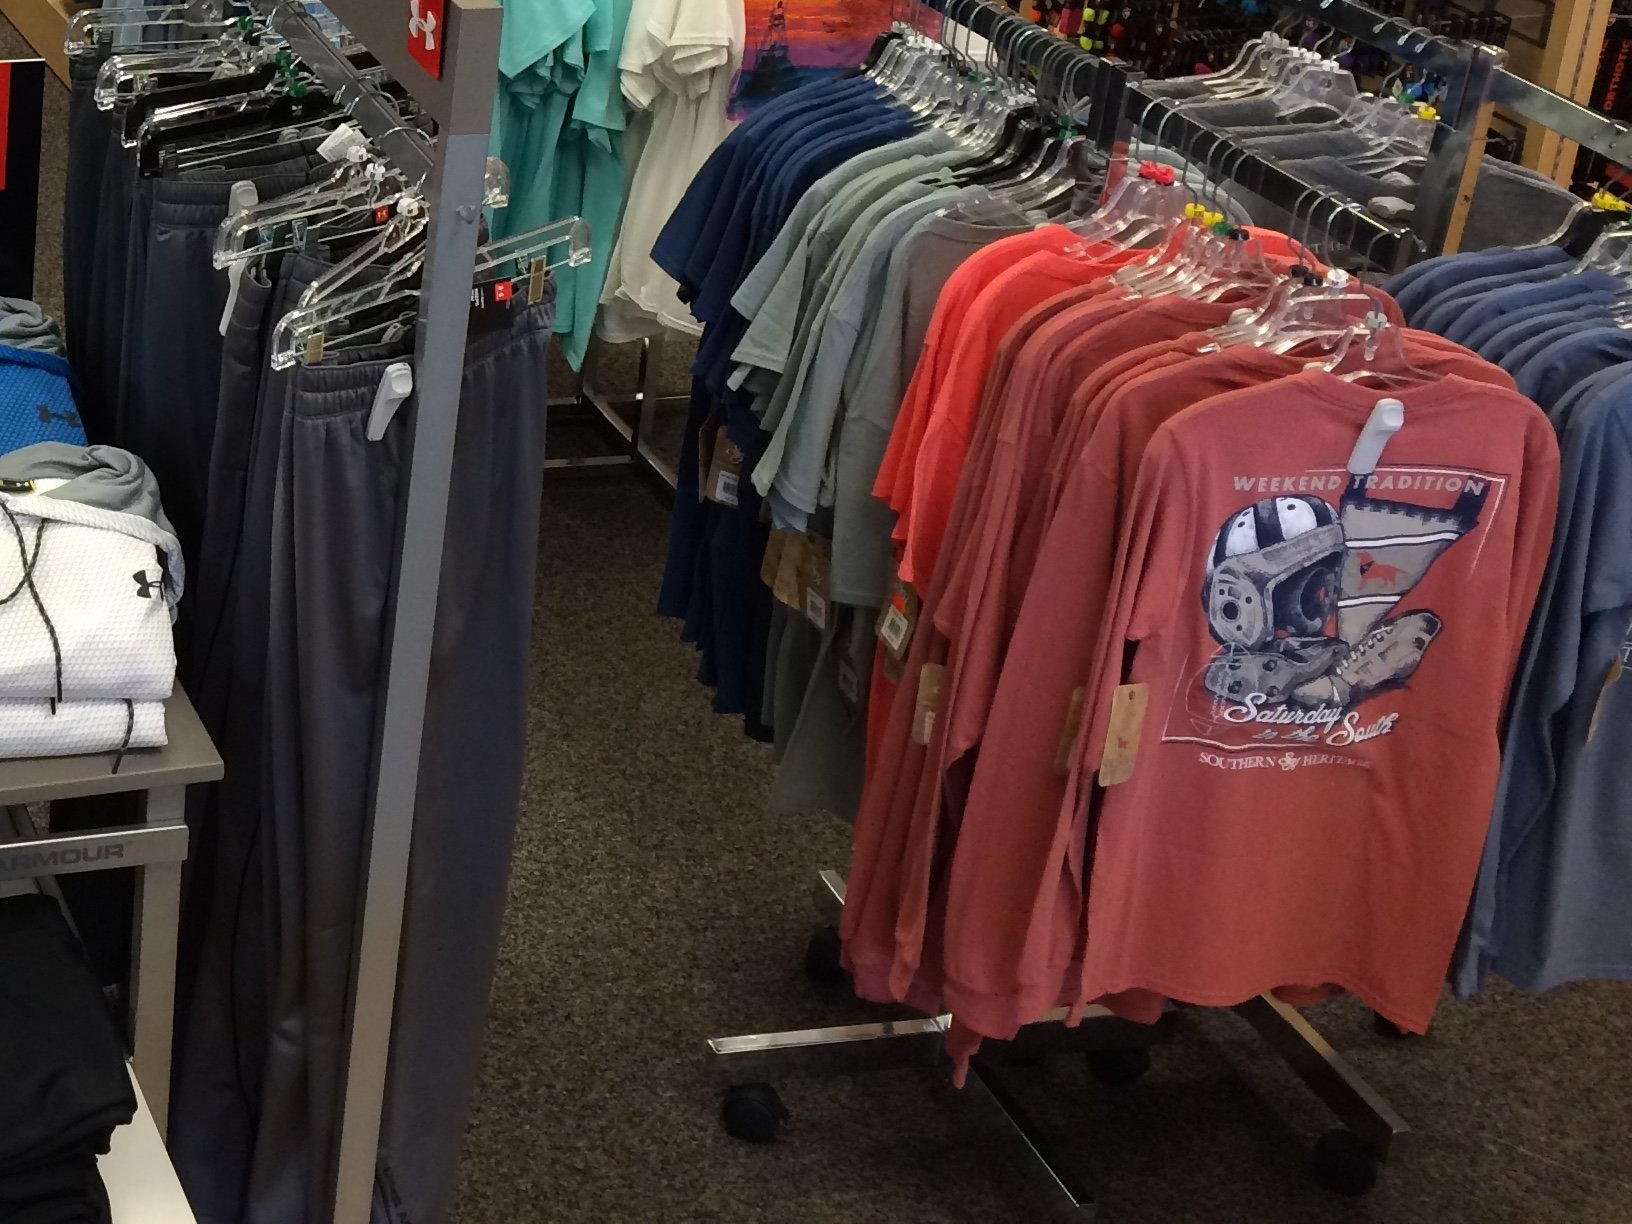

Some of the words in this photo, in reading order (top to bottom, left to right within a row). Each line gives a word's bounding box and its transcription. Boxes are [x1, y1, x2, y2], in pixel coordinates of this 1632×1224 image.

[1233, 475, 1342, 493] WEEKEND
[1353, 475, 1485, 496] TRADITION
[1223, 692, 1343, 729] Saturday
[1326, 711, 1399, 747] South
[1199, 751, 1278, 769] SOUTHERN
